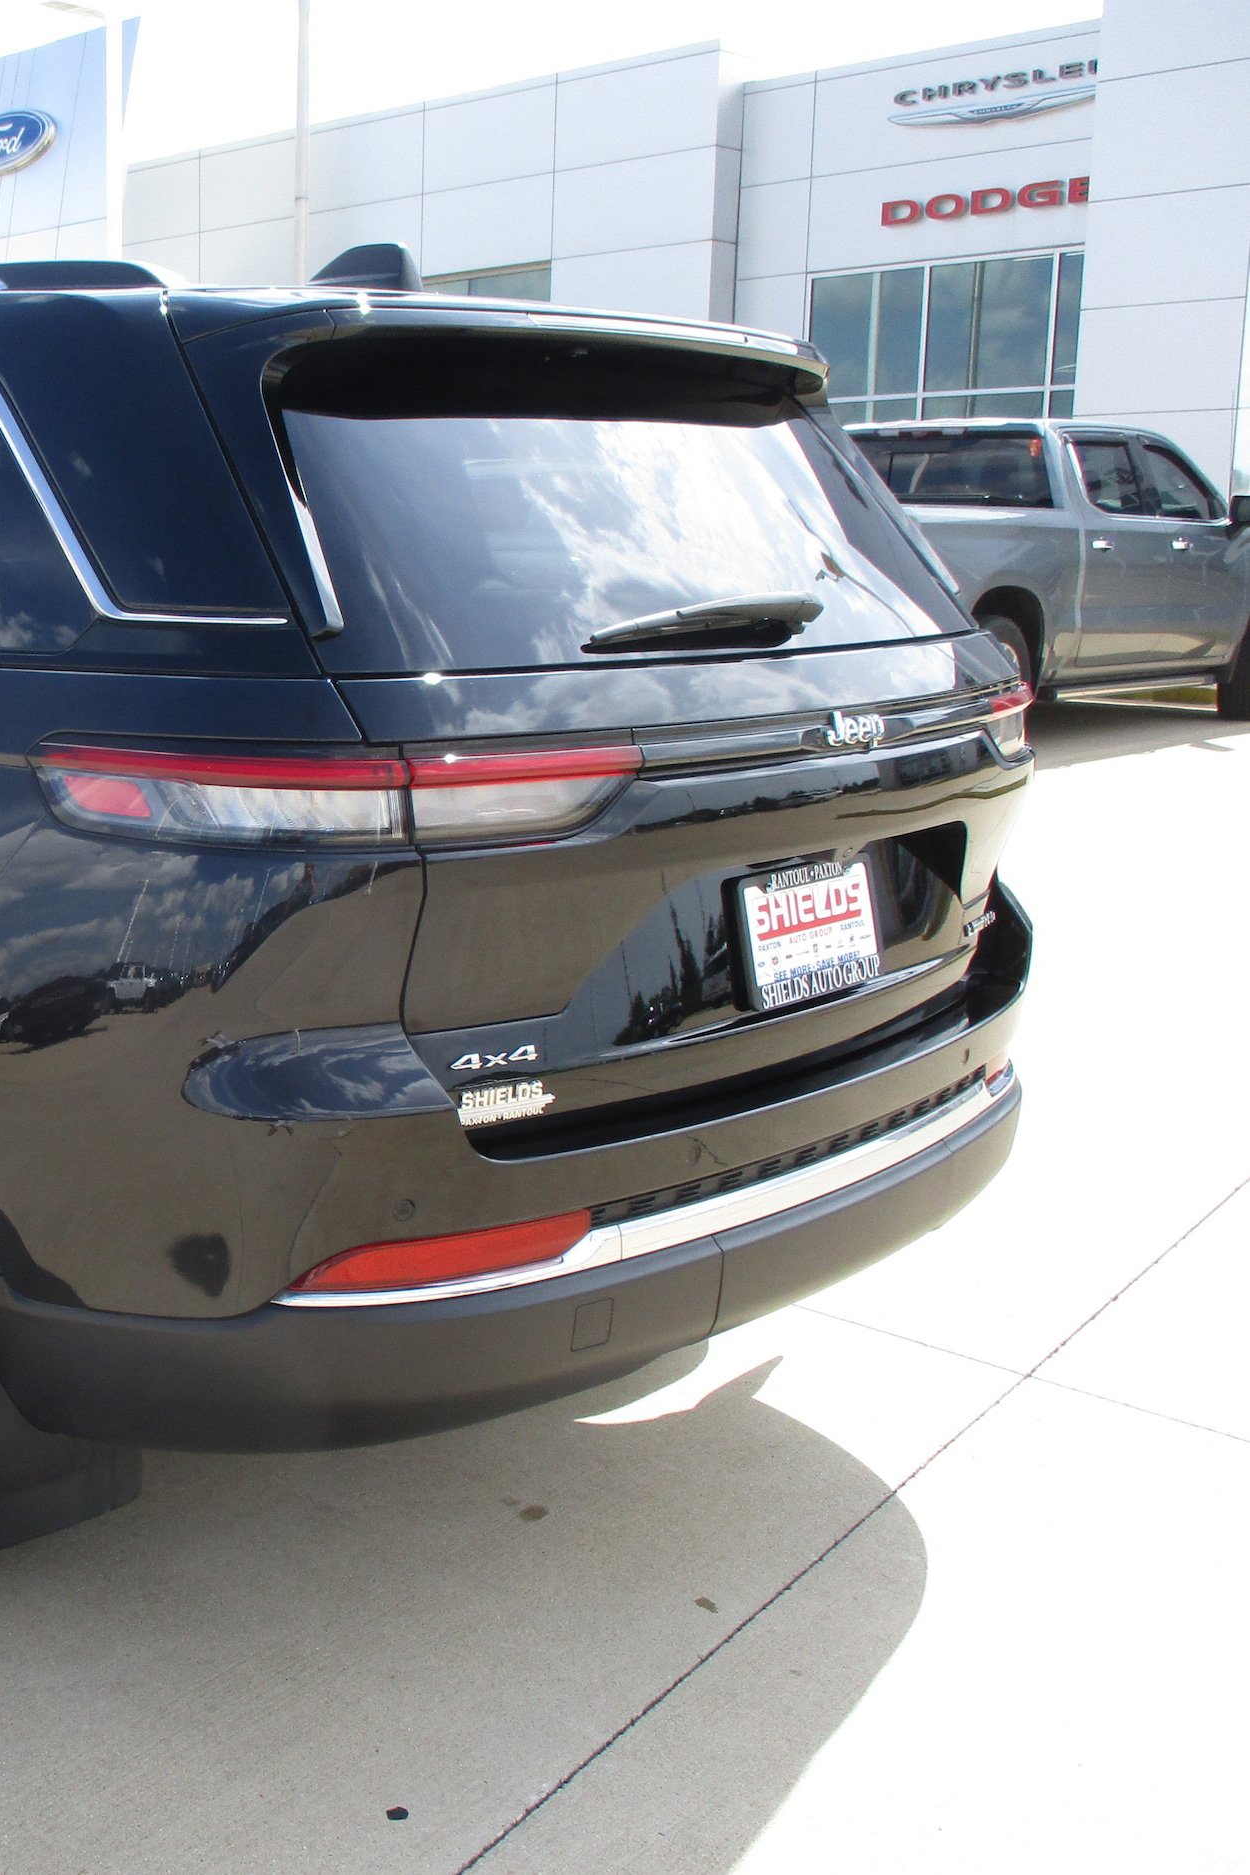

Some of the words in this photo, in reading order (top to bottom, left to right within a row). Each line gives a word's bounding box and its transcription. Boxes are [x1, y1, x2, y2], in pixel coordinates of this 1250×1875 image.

[881, 176, 1090, 226] DODGE
[827, 711, 885, 748] Jeep
[770, 866, 811, 889] RANTOUL
[813, 861, 843, 880] PAXTON
[752, 877, 862, 936] SHIELDS
[789, 933, 807, 945] AUTO
[810, 926, 832, 940] GROUP
[816, 957, 835, 970] SAVE
[761, 975, 810, 1010] SHIELDS
[811, 964, 843, 995] AUTO
[844, 955, 880, 986] GROUP
[450, 1044, 539, 1070] 4x4
[461, 1080, 544, 1110] SHIELDS
[460, 1114, 497, 1127] PAXTON
[502, 1106, 544, 1121] RANTOUL
